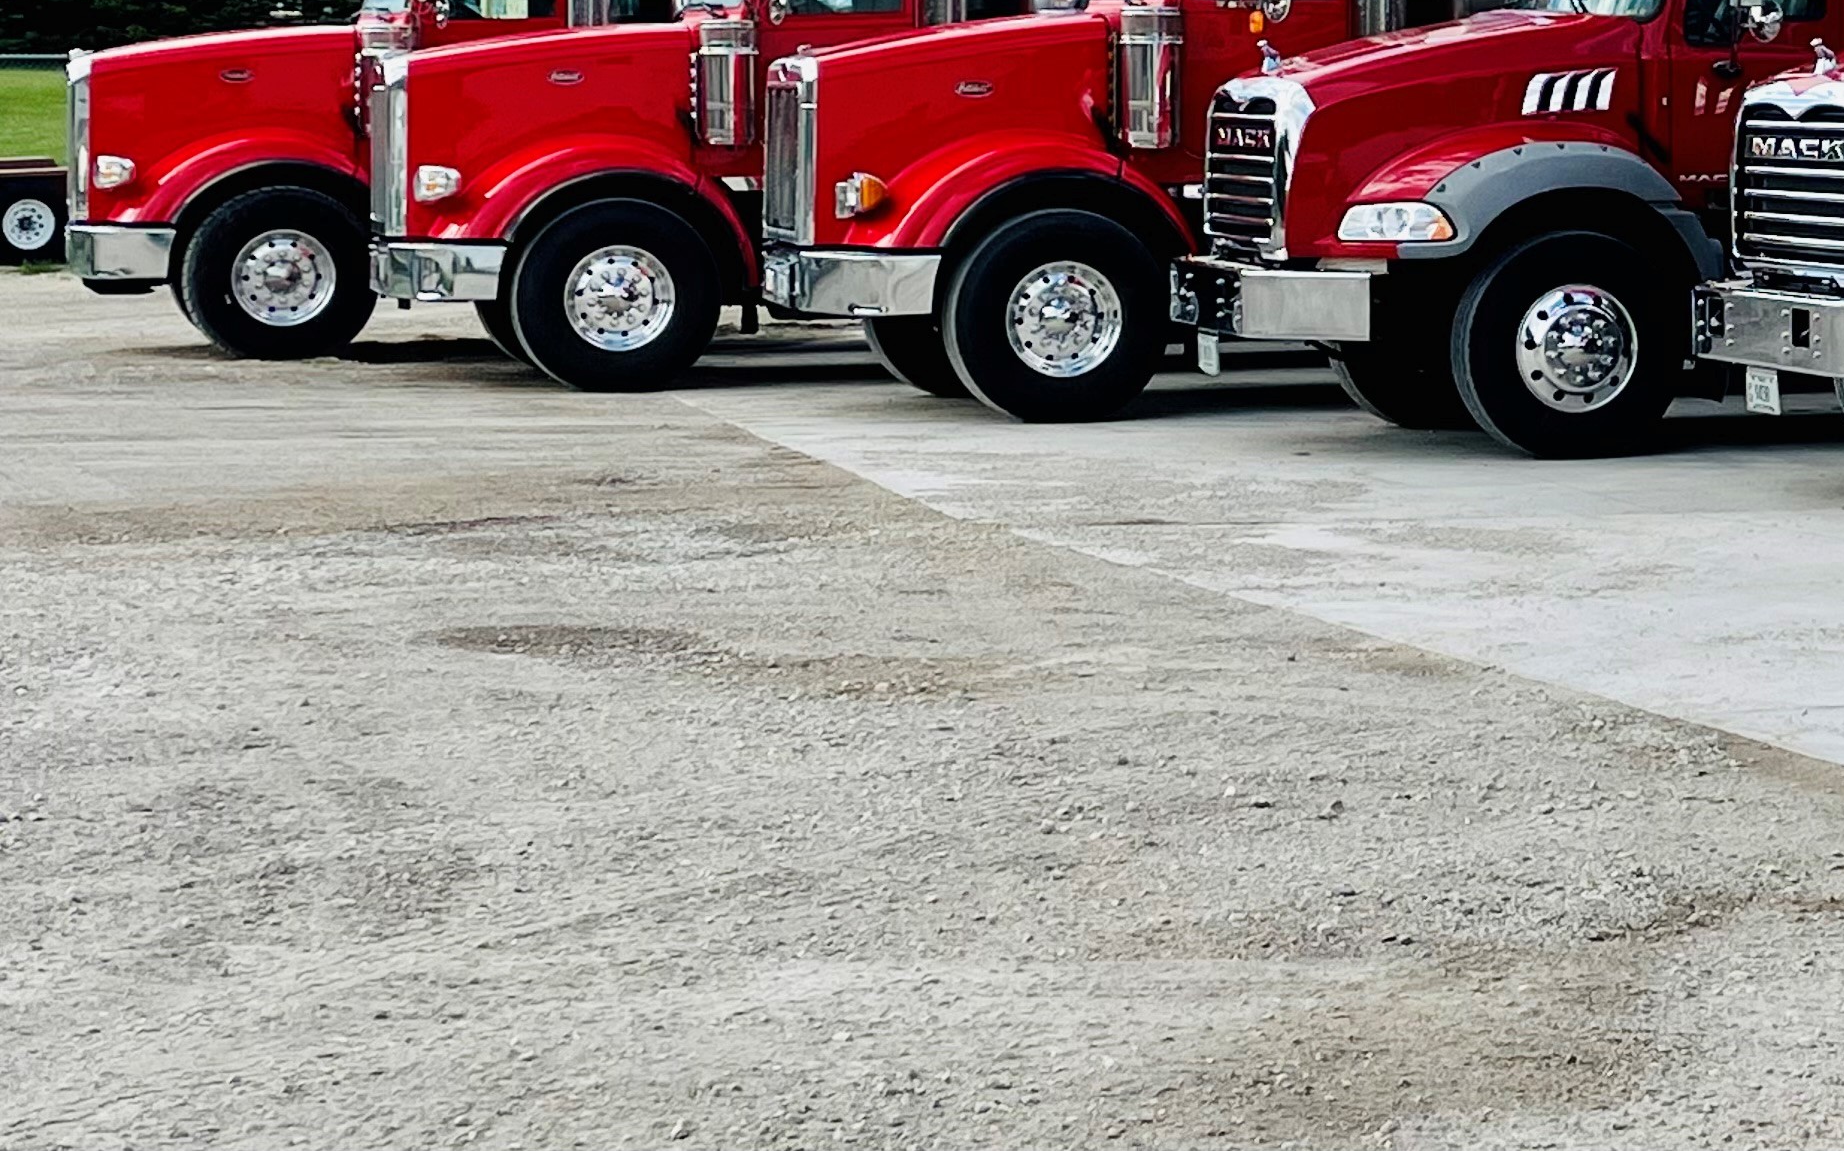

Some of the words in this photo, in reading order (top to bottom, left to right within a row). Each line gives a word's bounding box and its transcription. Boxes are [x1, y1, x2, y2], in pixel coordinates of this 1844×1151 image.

[1216, 126, 1270, 148] MACK
[1751, 136, 1844, 161] MACK
[1679, 173, 1729, 182] MAC
